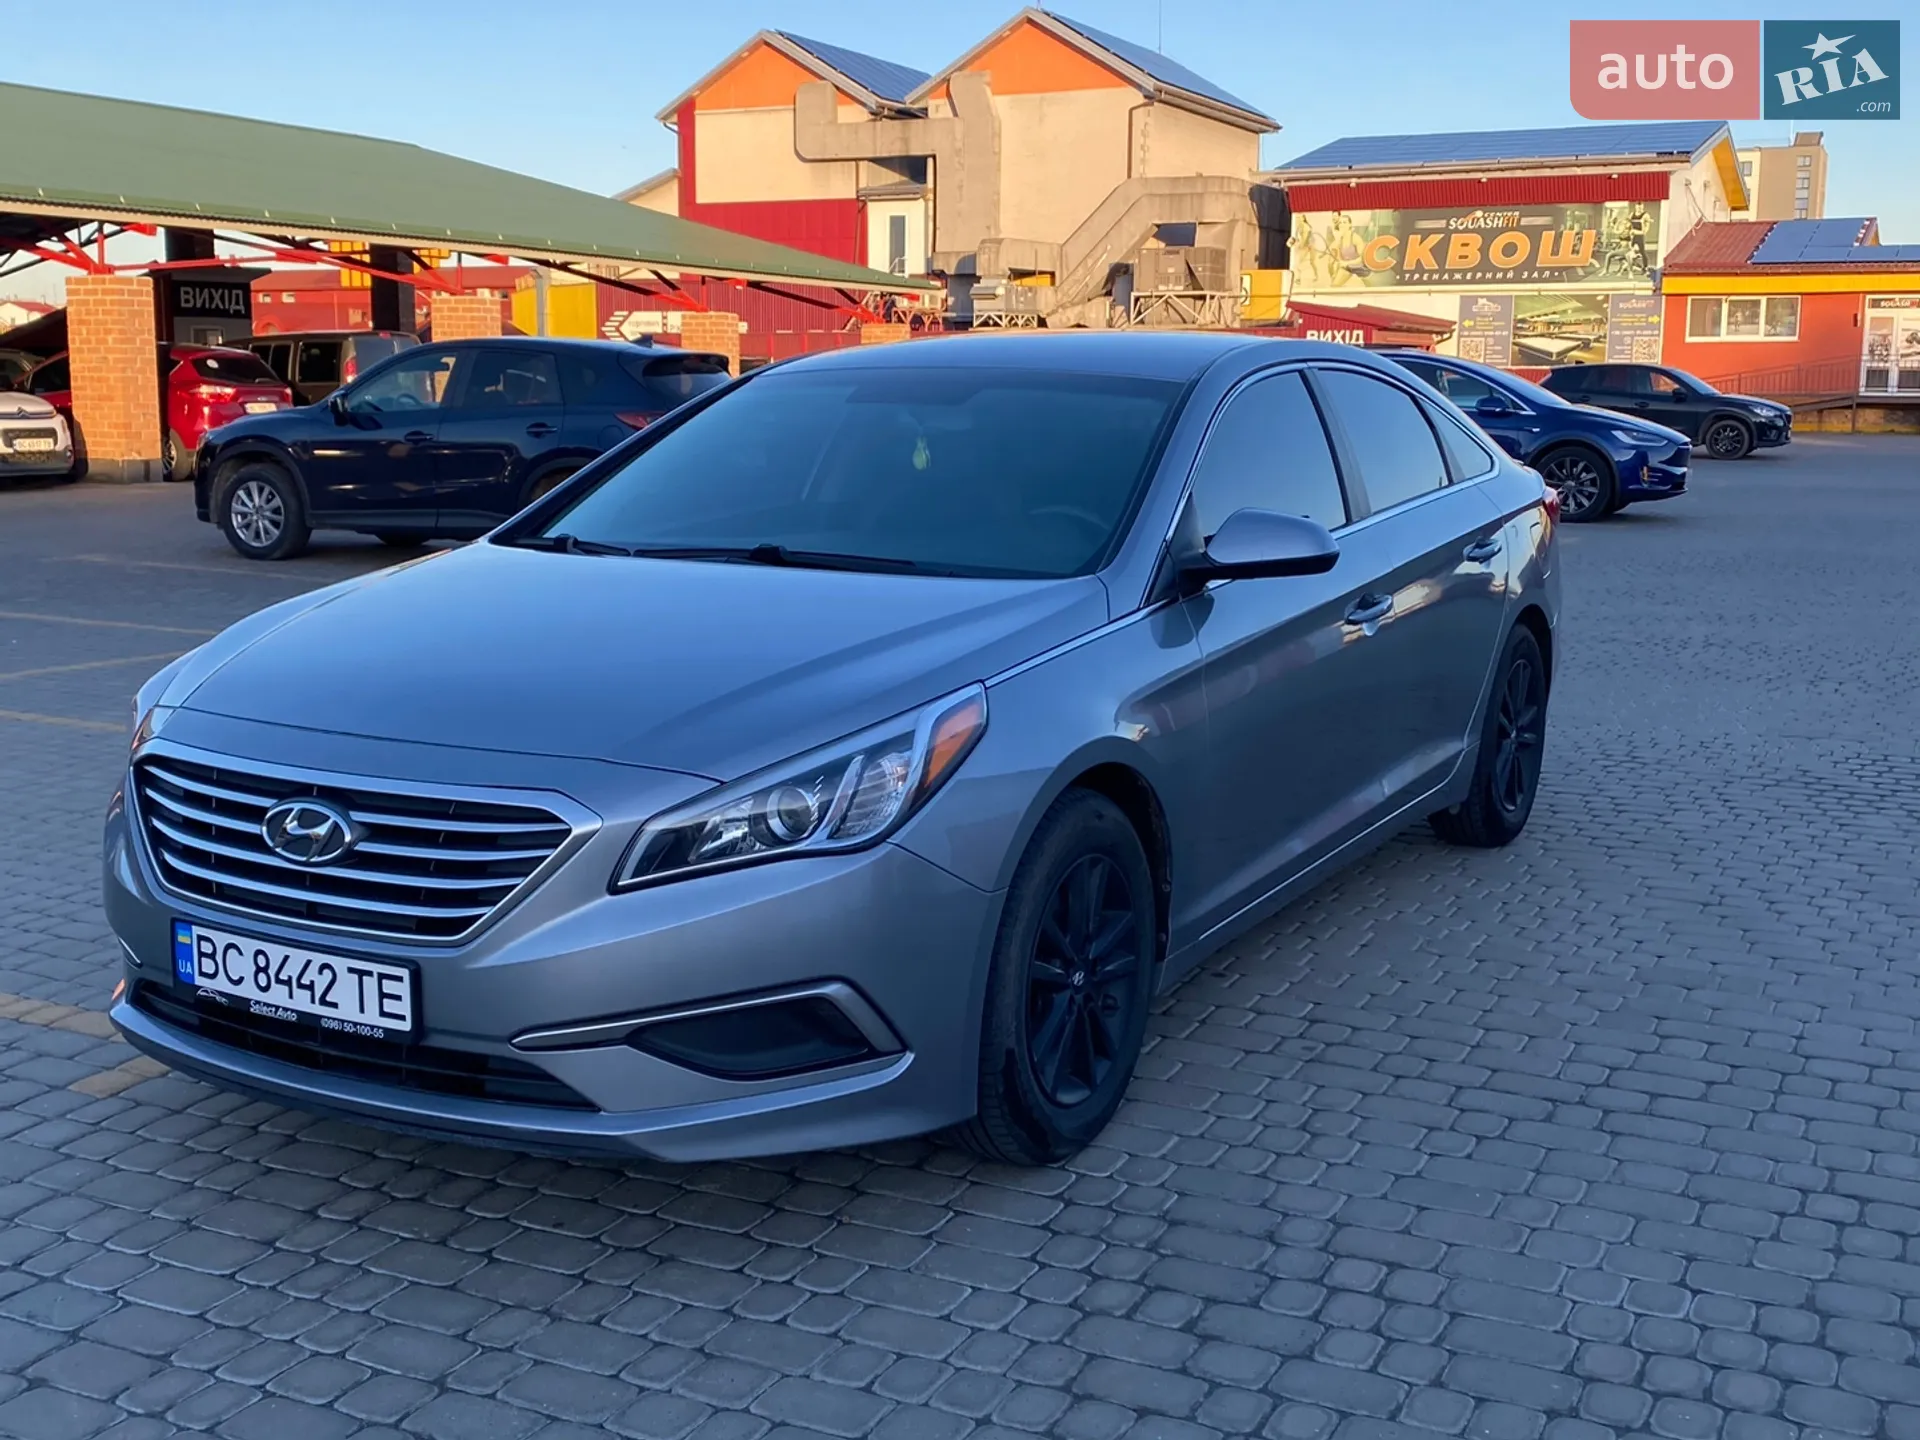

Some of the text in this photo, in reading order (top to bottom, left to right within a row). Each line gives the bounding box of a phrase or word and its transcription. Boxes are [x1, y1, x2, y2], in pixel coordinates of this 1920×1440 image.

[1363, 230, 1596, 271] СКВОШ
[1404, 270, 1550, 281] ТРЕНАЖЕРНИЙ ЗАЛ
[180, 287, 245, 314] ВИХІД
[1306, 329, 1364, 347] ВИХІД
[178, 960, 193, 975] UA
[197, 934, 407, 1022] BC 8442 TE
[250, 1001, 276, 1016] Select
[343, 1022, 384, 1039] 50-100-55
